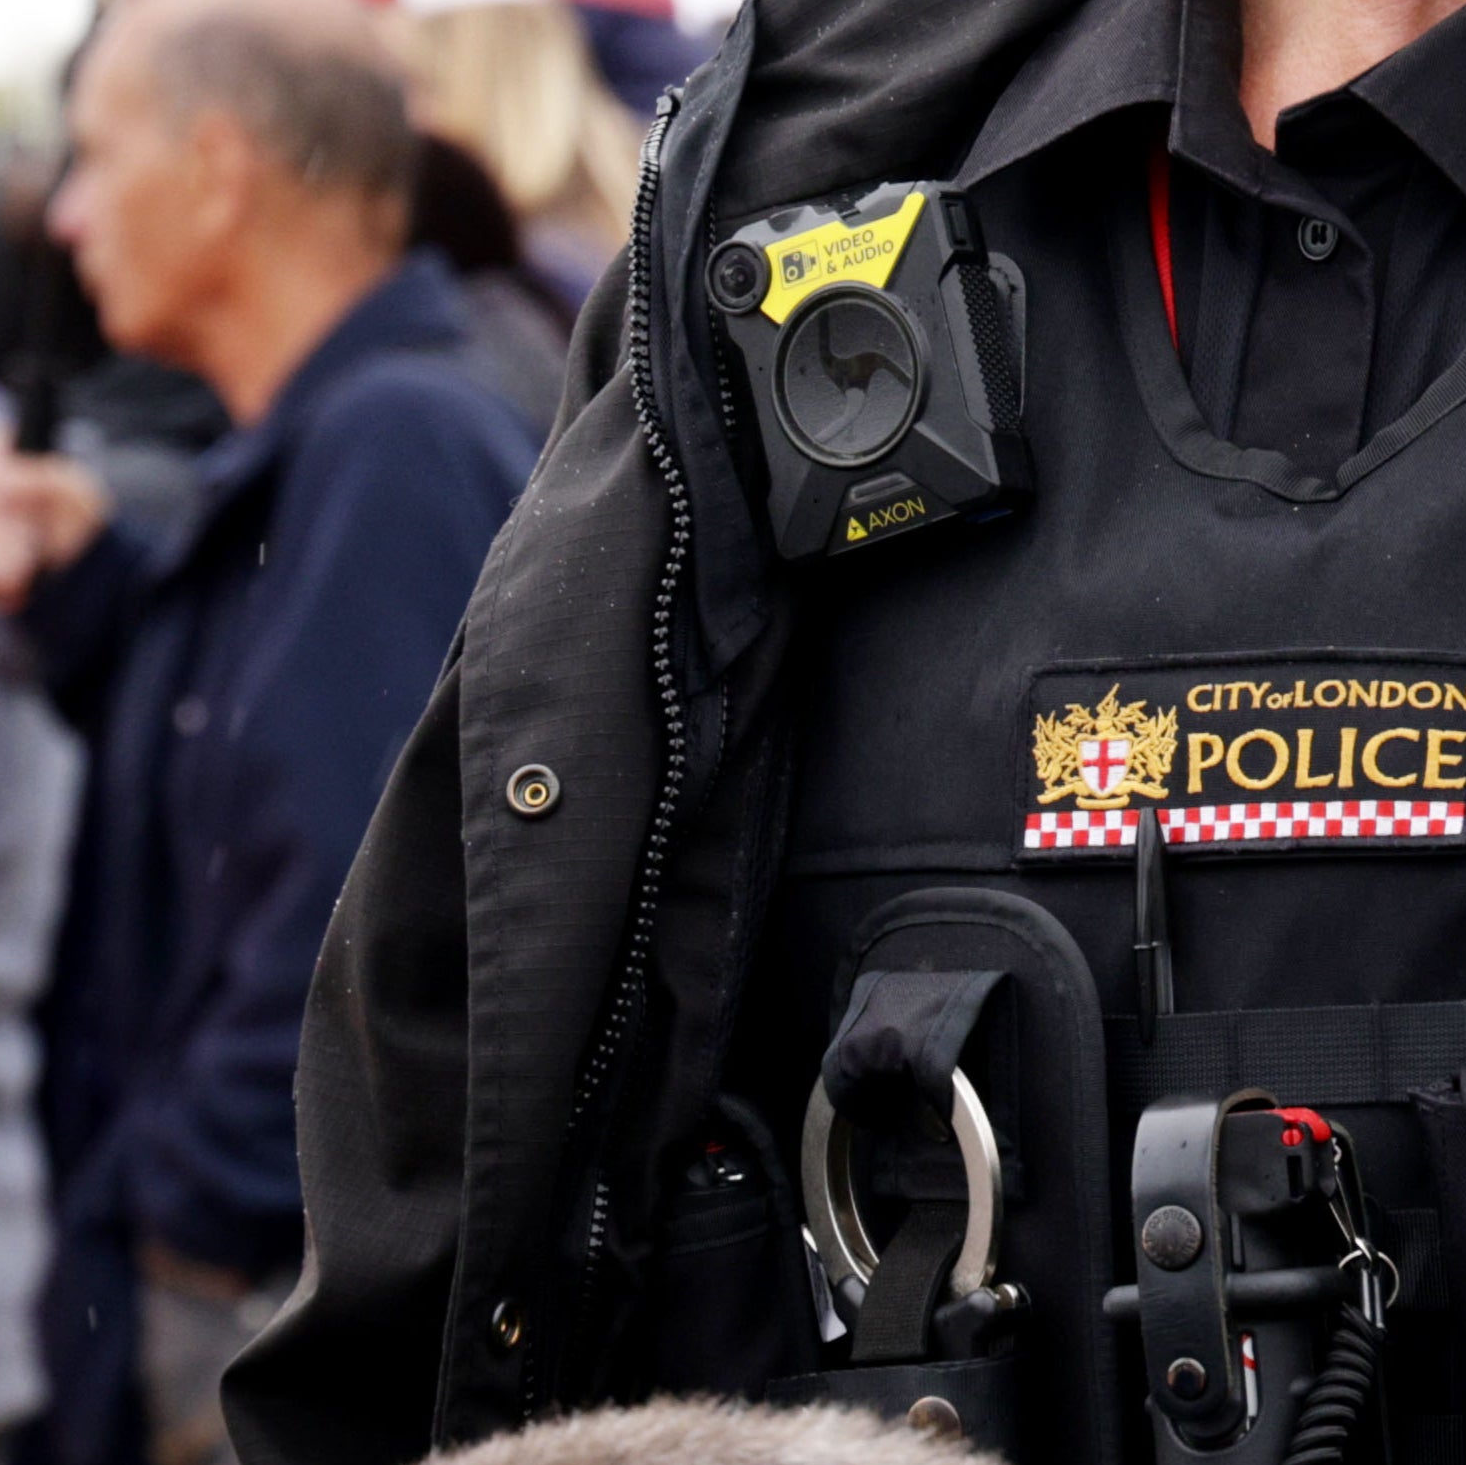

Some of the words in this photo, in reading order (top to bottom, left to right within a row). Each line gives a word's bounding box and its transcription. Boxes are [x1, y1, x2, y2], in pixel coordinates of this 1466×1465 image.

[823, 229, 875, 257] VIDEO
[826, 261, 837, 274] &
[842, 239, 894, 269] AUDIO
[869, 496, 926, 532] AXON
[1186, 681, 1272, 713] CITY
